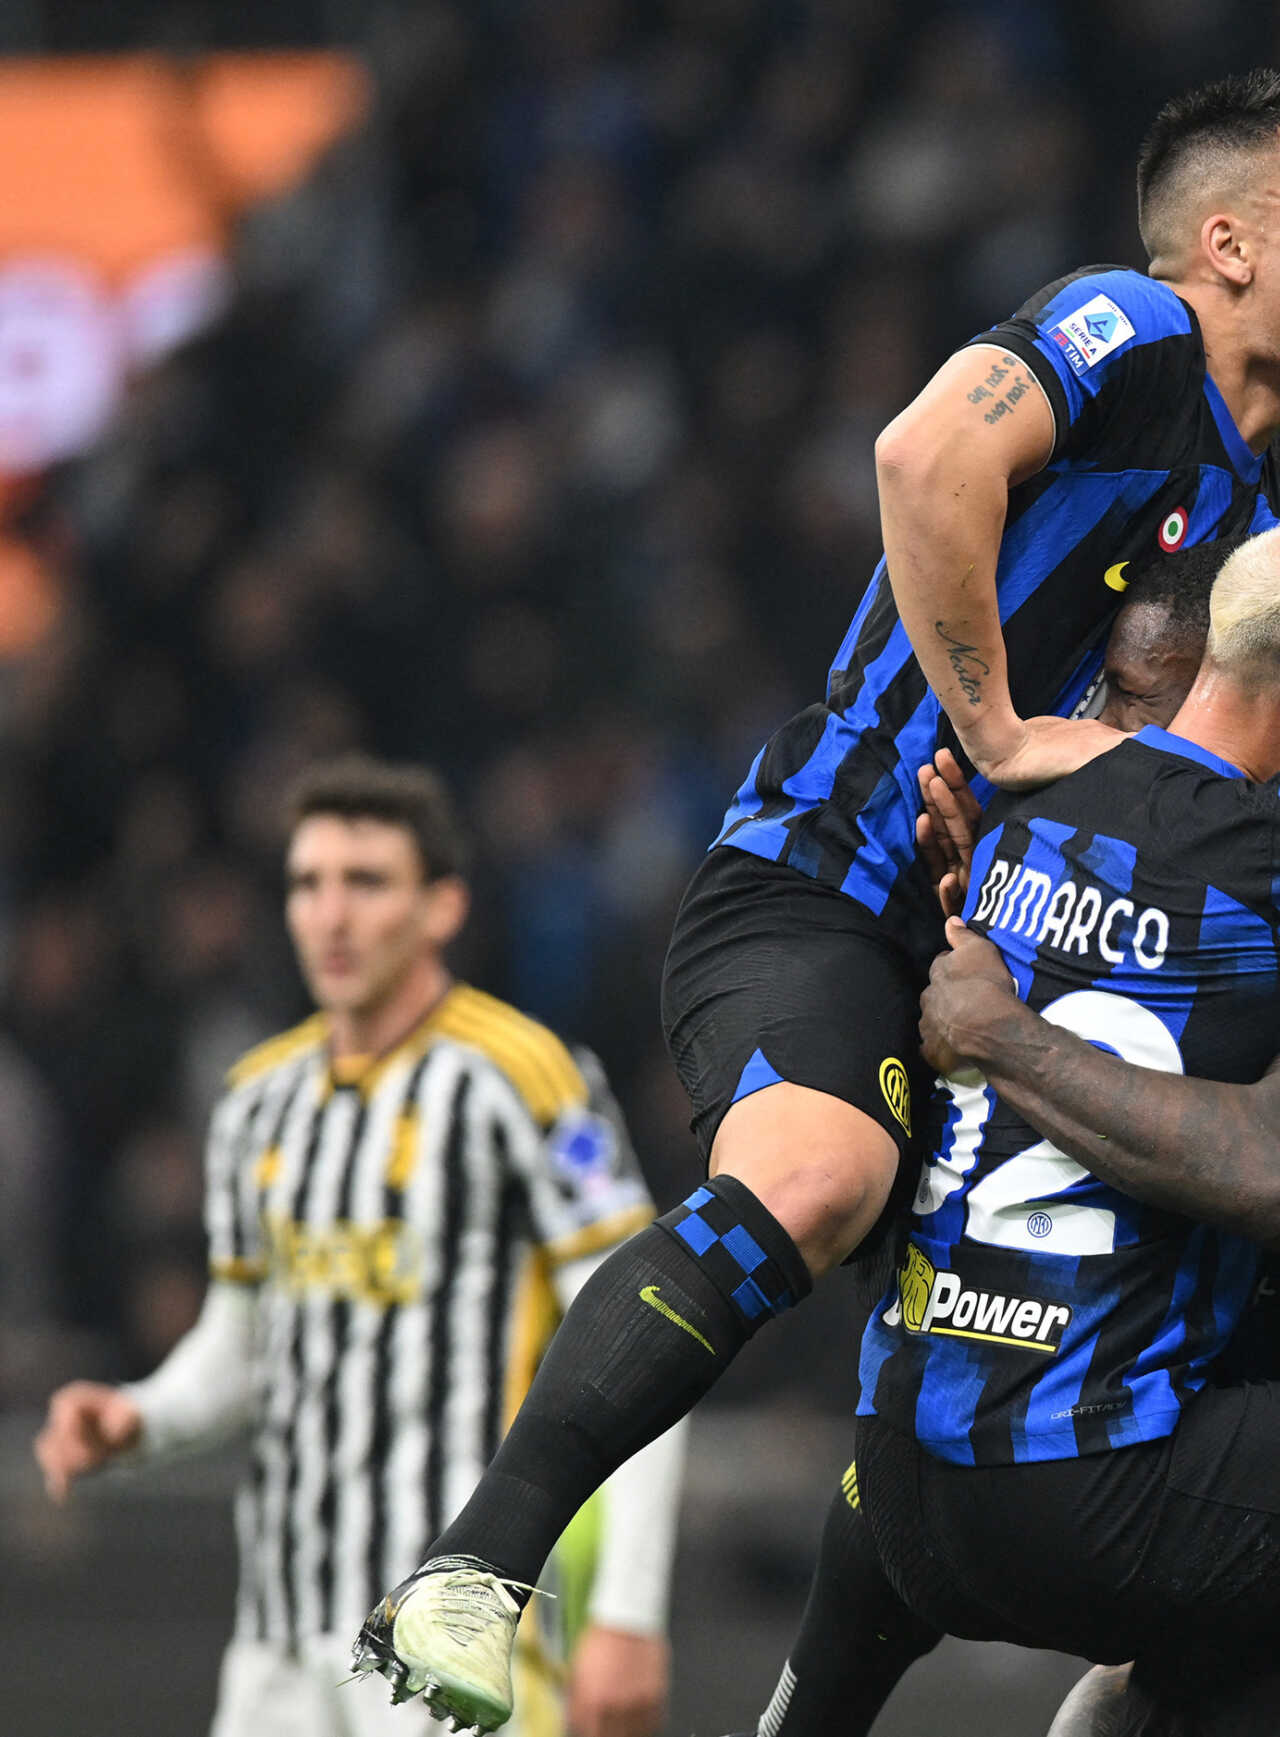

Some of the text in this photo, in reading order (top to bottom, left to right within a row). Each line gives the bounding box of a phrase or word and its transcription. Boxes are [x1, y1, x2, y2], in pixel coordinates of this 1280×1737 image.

[1069, 322, 1097, 355] SERIE A
[1065, 343, 1085, 369] TIM
[984, 364, 1009, 388] you
[1005, 376, 1030, 405] you
[984, 400, 1014, 424] love
[971, 859, 1170, 970] DIMARCO
[920, 1271, 1070, 1342] Power
